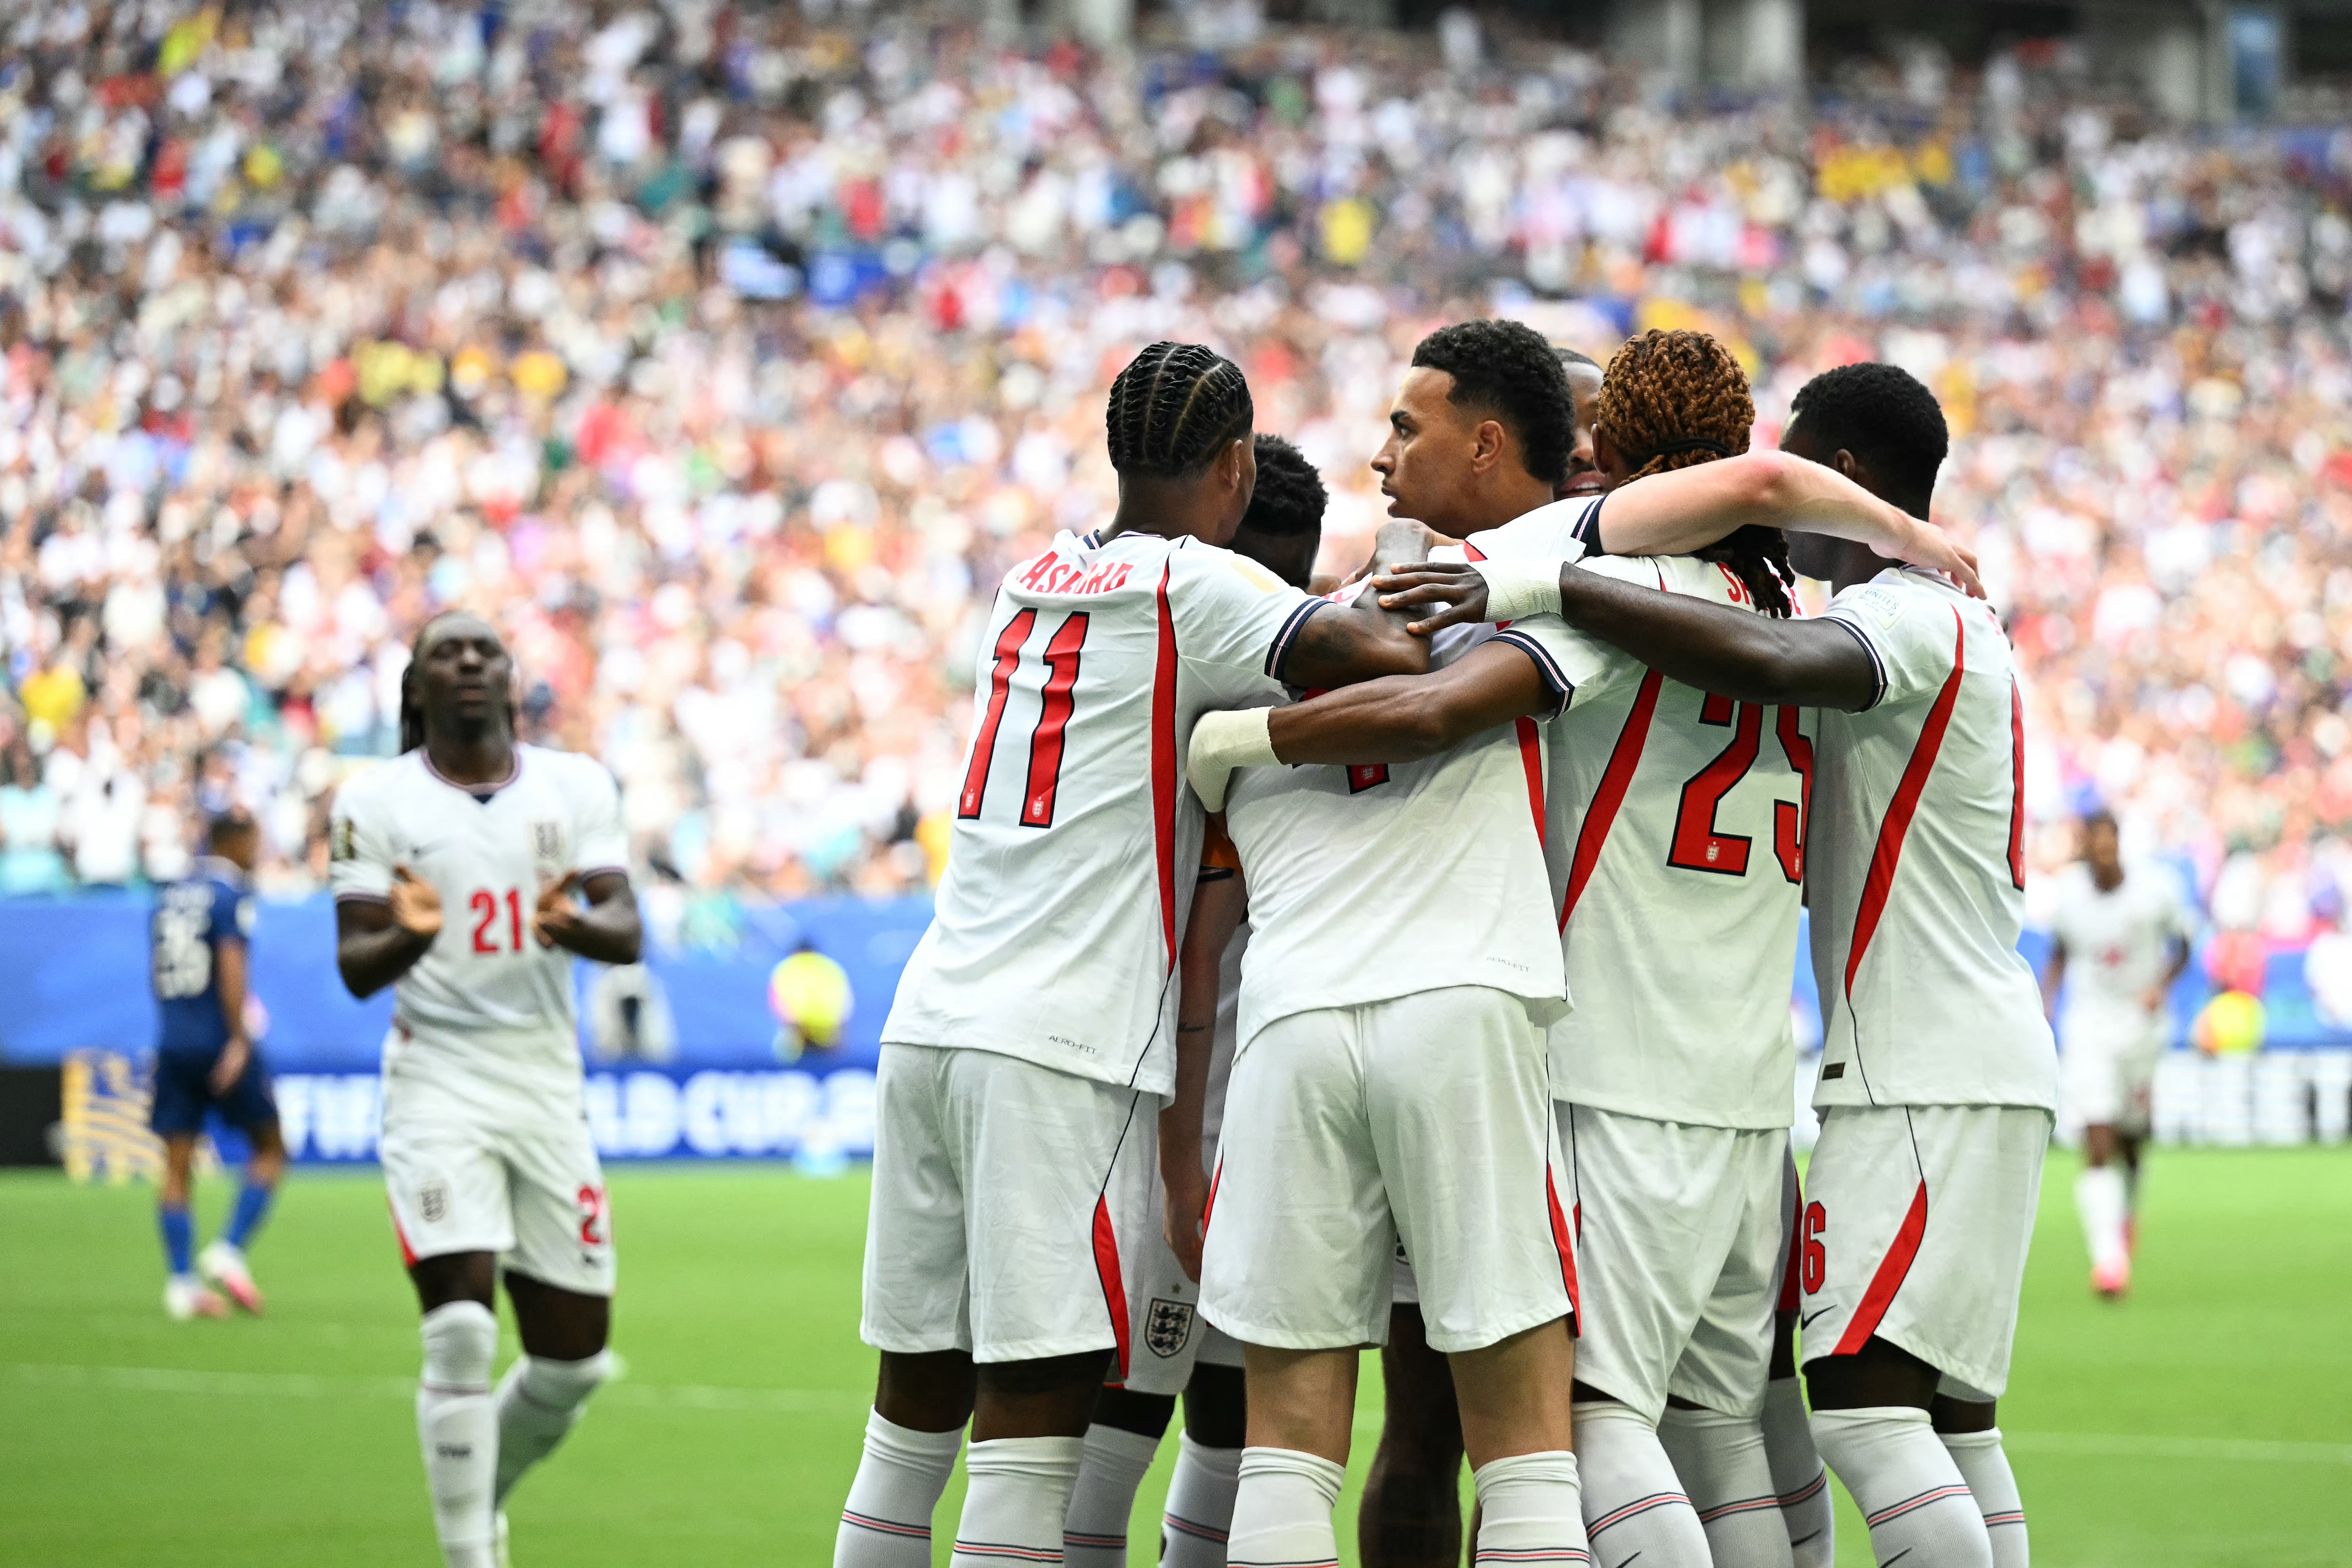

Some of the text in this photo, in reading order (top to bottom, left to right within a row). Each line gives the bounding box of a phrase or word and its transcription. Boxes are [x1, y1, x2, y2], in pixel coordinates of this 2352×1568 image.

[958, 607, 1090, 829] 11
[1666, 692, 1813, 886] 25
[470, 887, 523, 954] 21
[1049, 1035, 1097, 1054] AERO-FIT
[1802, 1200, 1826, 1295] 6
